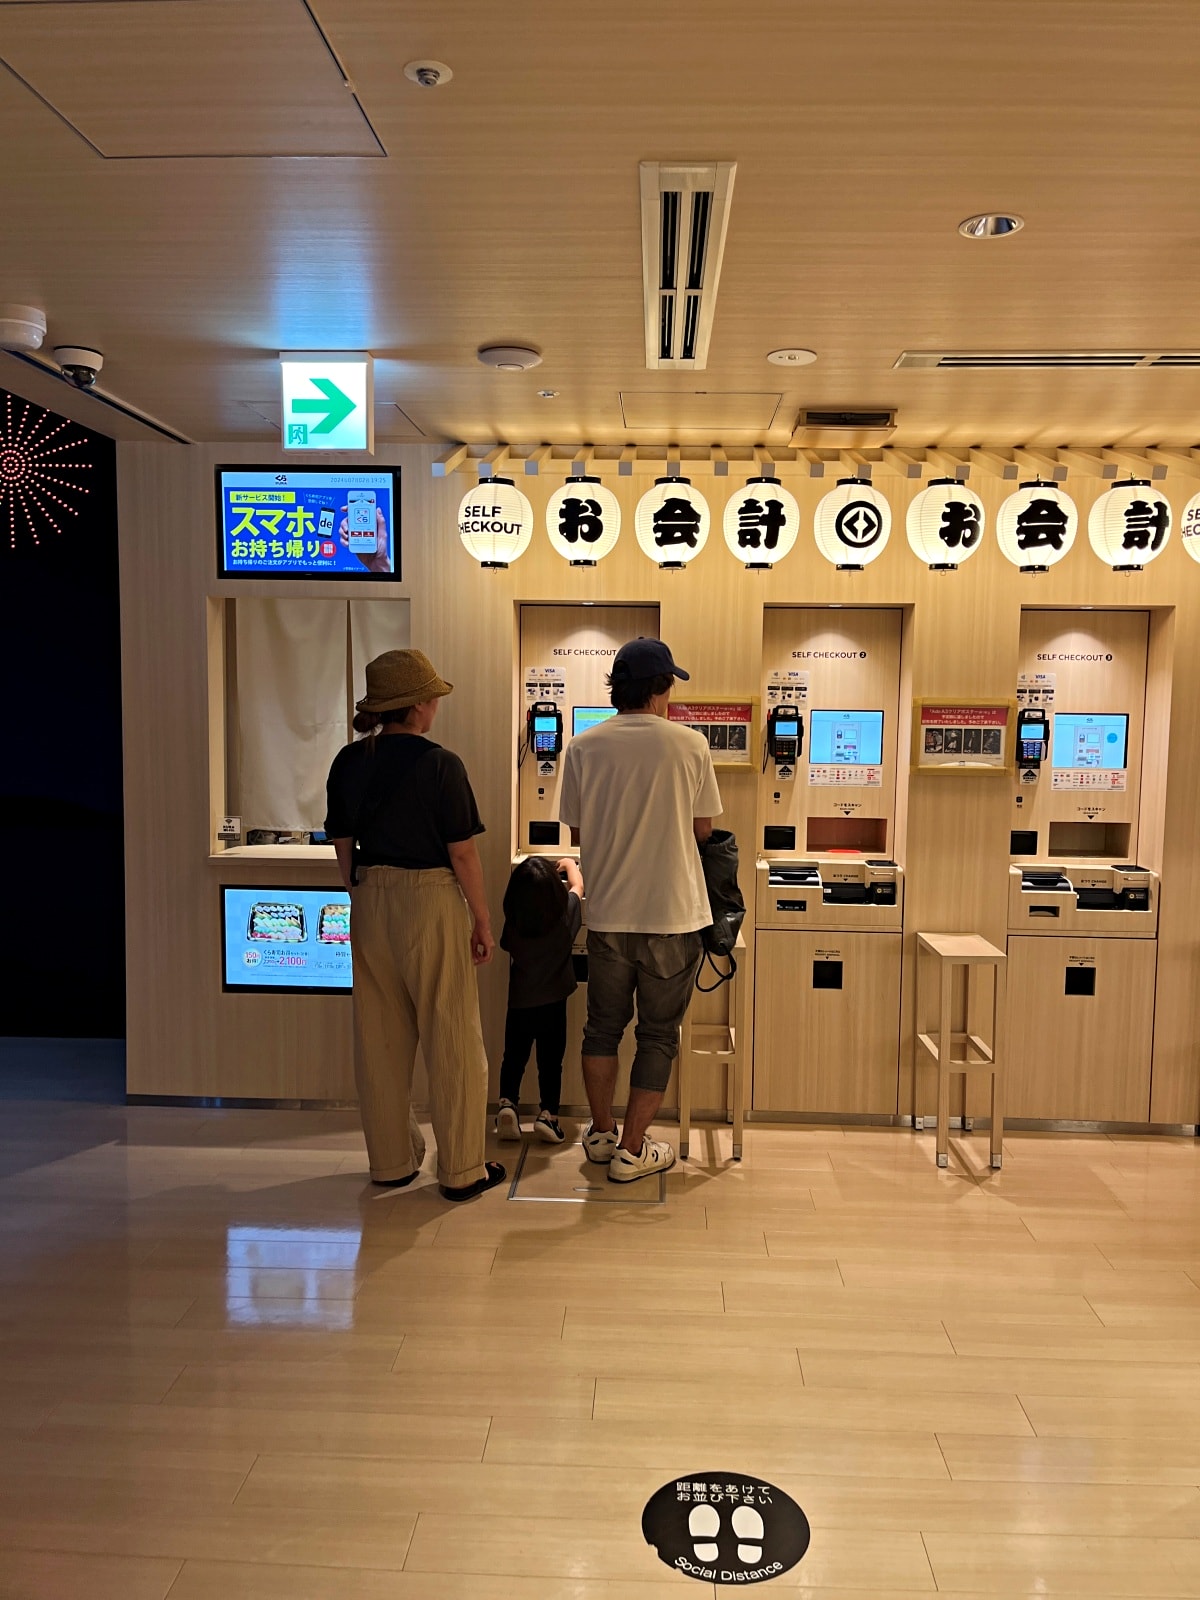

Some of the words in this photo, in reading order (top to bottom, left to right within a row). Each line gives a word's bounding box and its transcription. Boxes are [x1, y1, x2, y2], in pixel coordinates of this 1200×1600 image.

[235, 493, 286, 502] 新サービス開始!
[464, 505, 502, 518] SELF
[230, 505, 316, 538] スマホ
[319, 518, 333, 530] de
[458, 520, 523, 535] HECKOUT
[558, 497, 604, 544] お
[653, 497, 702, 548] 会
[737, 498, 787, 549] 計
[939, 501, 982, 549] お
[1016, 498, 1069, 551] 会
[1122, 500, 1170, 551] 計
[231, 539, 320, 559] お持ち帰り
[553, 648, 573, 656] SELF
[573, 648, 617, 656] CHECKOUT
[792, 651, 812, 659] SELF
[813, 651, 858, 659] CHECKOUT
[1037, 653, 1057, 661] SELF
[1058, 654, 1104, 662] CHECKOUT
[676, 1482, 771, 1494] 距離をあけて
[676, 1492, 774, 1505] お並び下さい
[674, 1556, 717, 1580] Social
[720, 1561, 784, 1581] Distance
